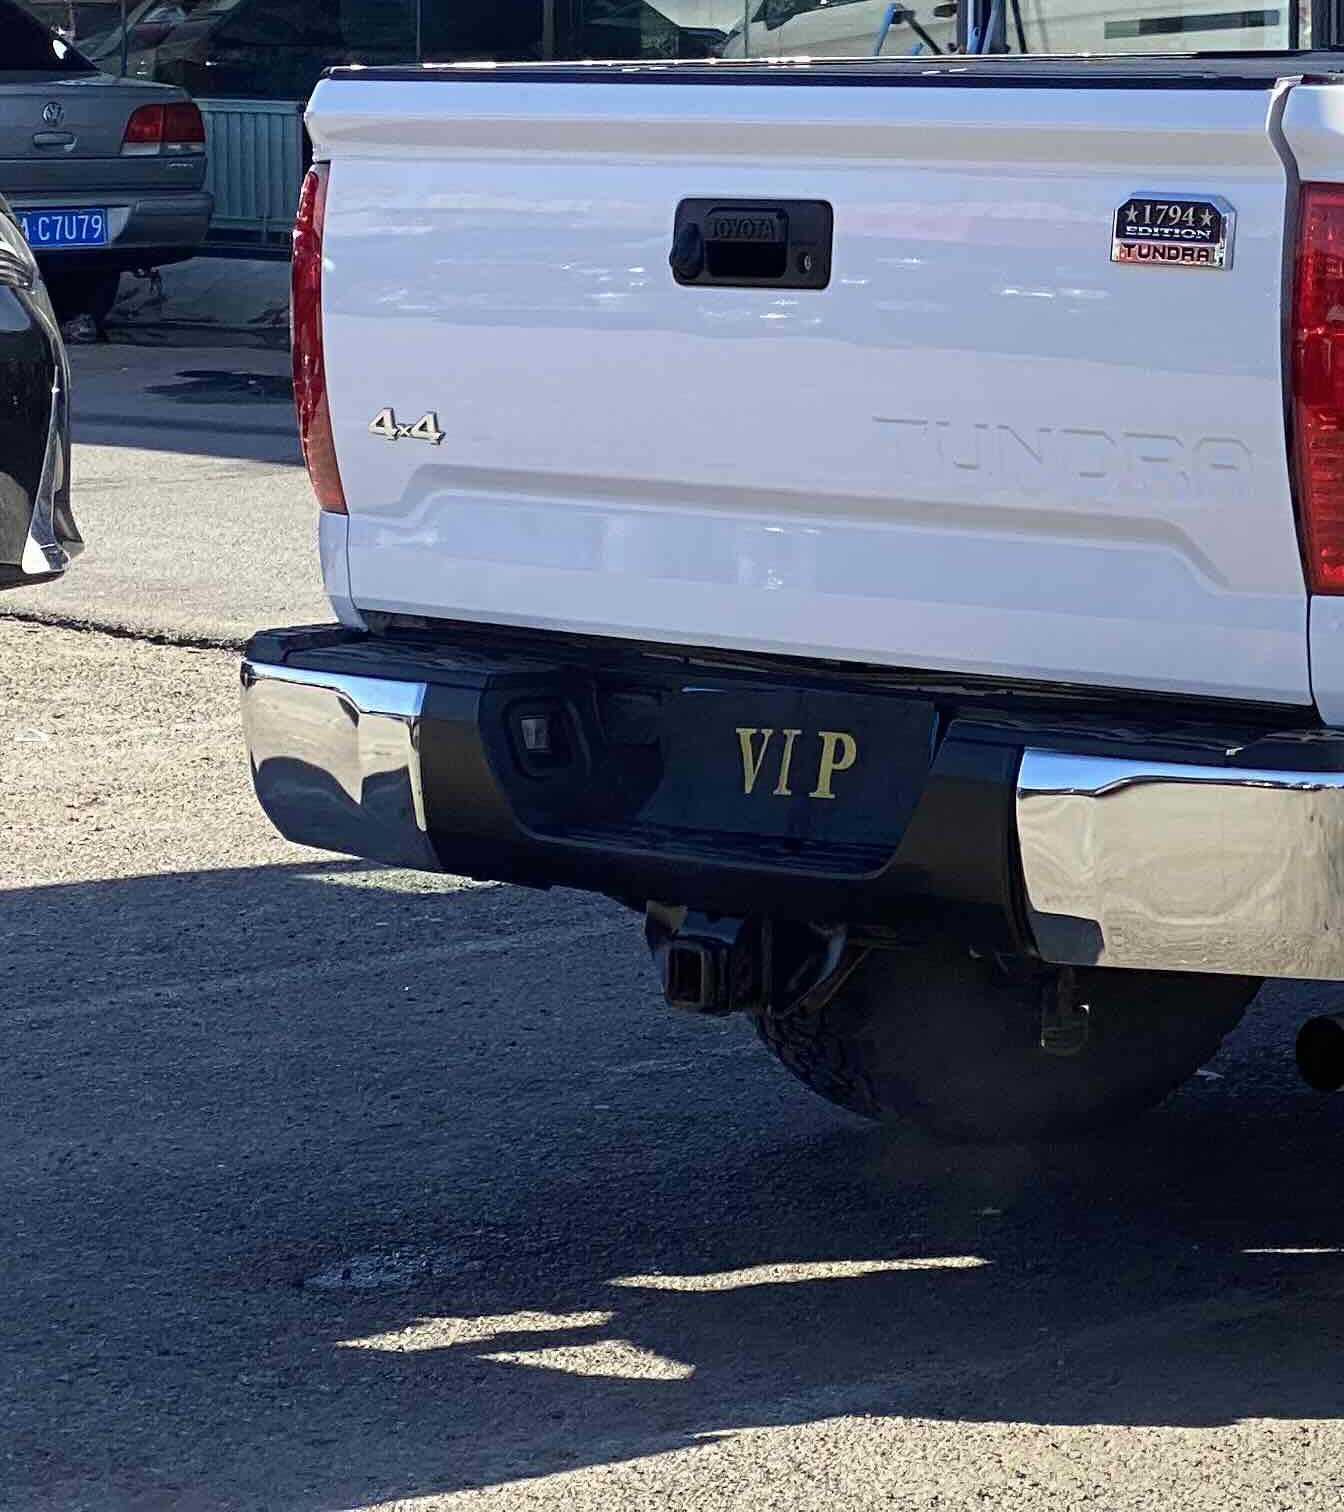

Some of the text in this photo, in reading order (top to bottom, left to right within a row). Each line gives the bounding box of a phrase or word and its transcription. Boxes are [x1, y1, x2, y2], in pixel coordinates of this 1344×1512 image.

[1143, 204, 1195, 227] 1794
[1125, 225, 1211, 240] EDITION
[1121, 242, 1212, 263] TUNDRA
[735, 727, 858, 799] VIP
